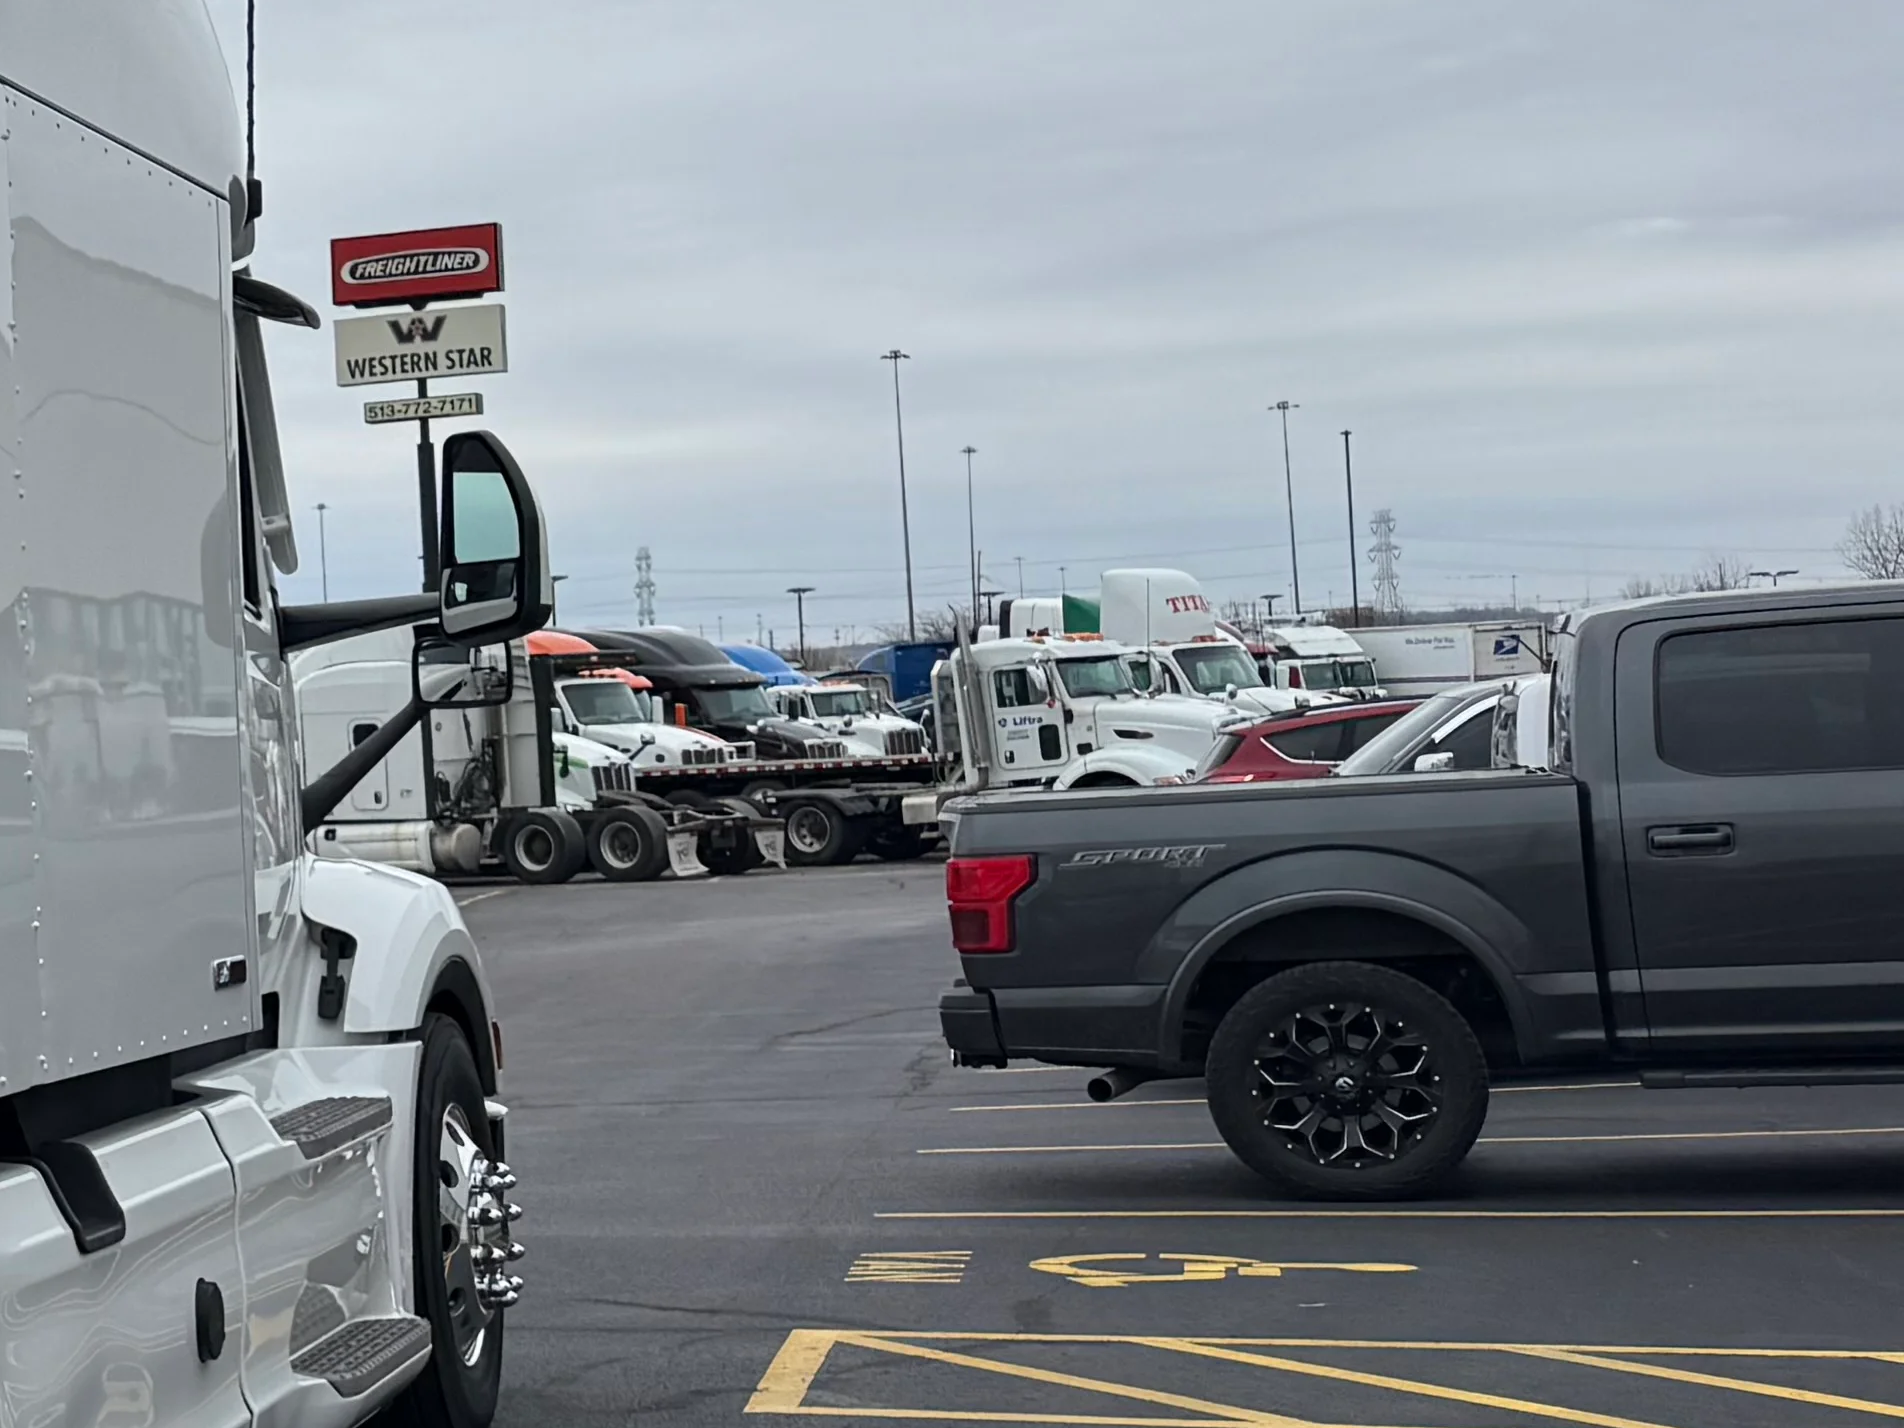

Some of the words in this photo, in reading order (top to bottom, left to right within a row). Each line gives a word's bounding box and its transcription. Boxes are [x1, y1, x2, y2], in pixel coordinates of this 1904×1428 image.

[355, 253, 476, 279] FREIGHTLINER
[346, 350, 438, 379] WESTERN
[445, 346, 493, 370] STAR
[367, 397, 473, 419] 513-772-7171
[1058, 844, 1226, 869] SPORT
